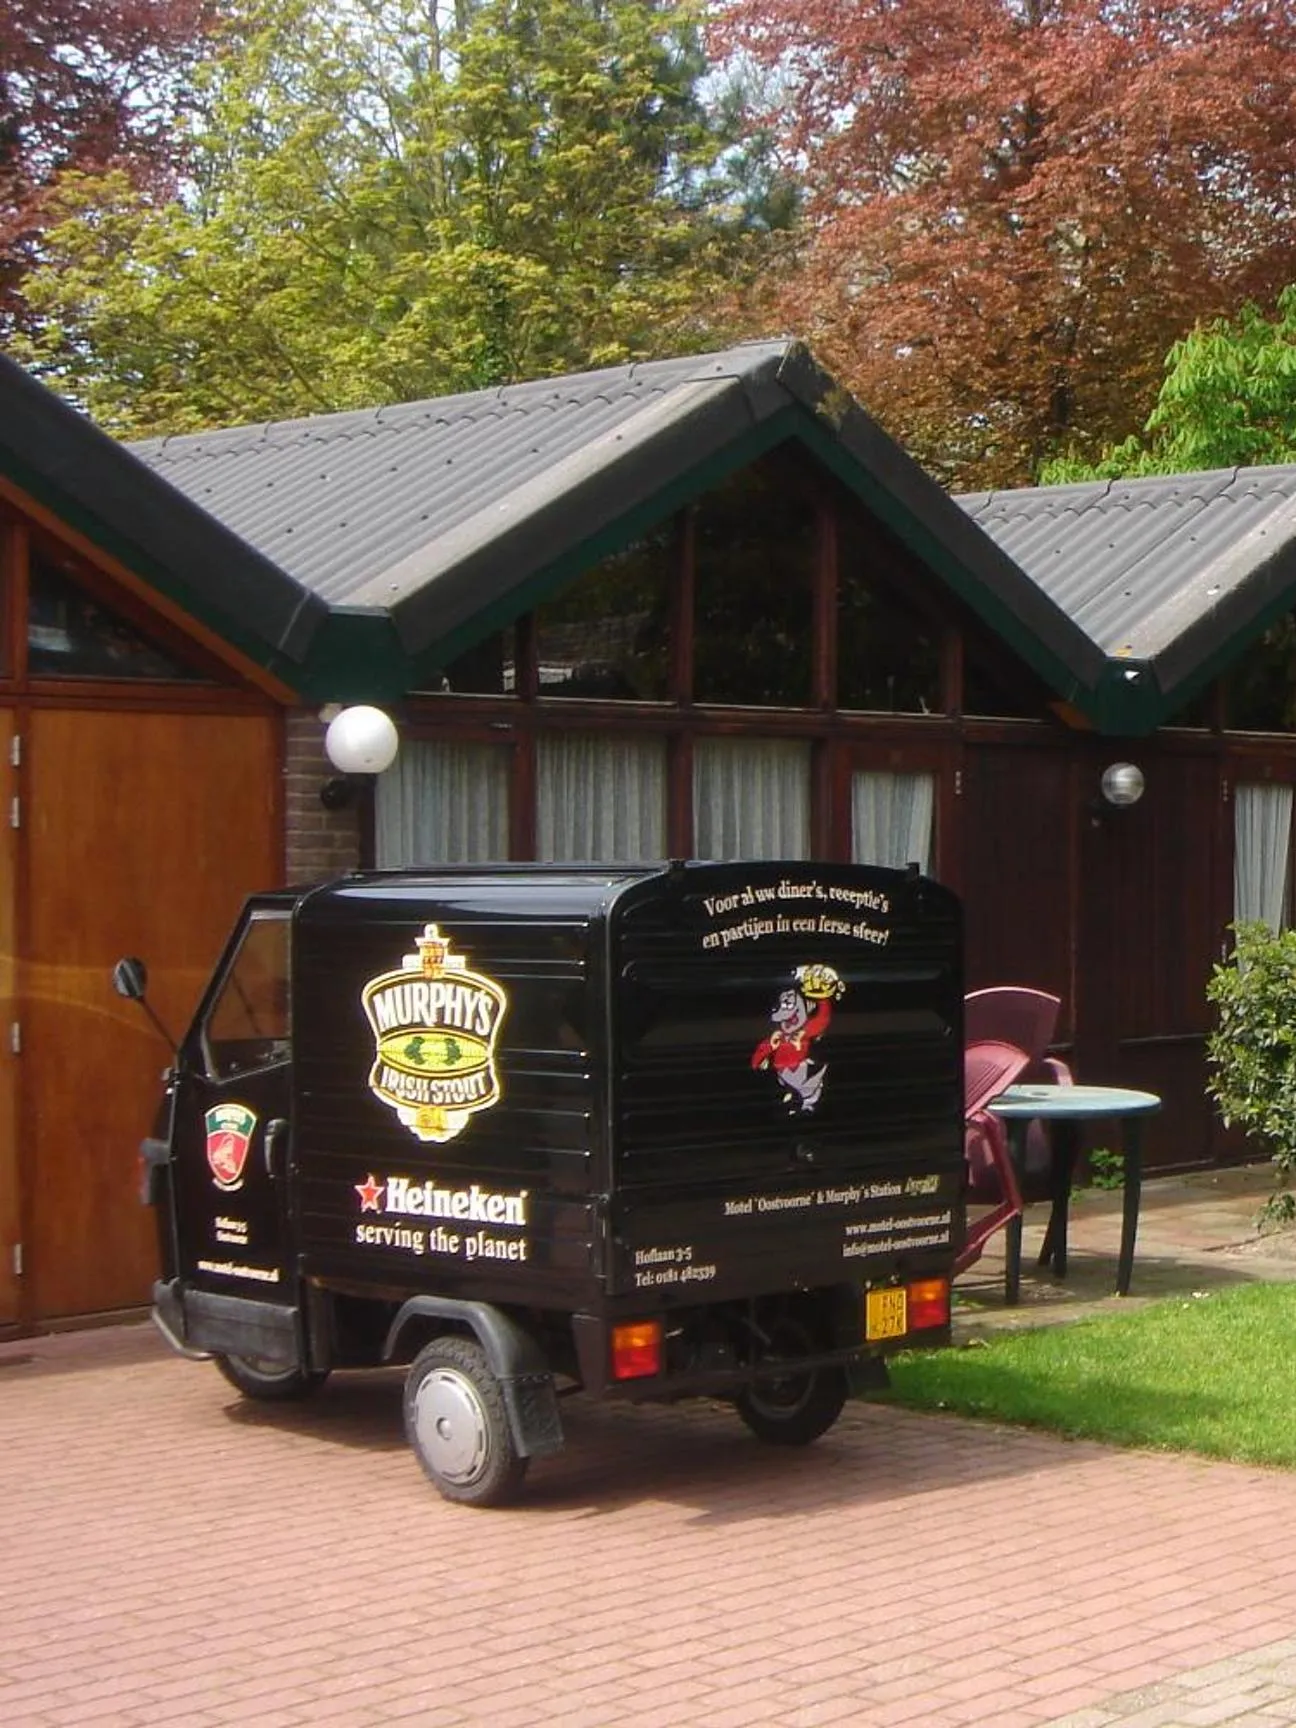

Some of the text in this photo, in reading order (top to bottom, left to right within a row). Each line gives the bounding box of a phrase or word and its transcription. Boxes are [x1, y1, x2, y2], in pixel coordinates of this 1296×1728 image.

[703, 880, 890, 917] Voor al uw diner's, receptie's
[702, 914, 889, 949] en partijen in een Ierse sfeer!
[372, 982, 494, 1036] MURPHY'S
[381, 1066, 487, 1104] IRISH STOUT
[386, 1176, 527, 1226] Heineken
[816, 1192, 825, 1205] &
[871, 1183, 901, 1198] Station
[355, 1222, 527, 1261] serving the planet
[675, 1246, 692, 1262] 3-5
[635, 1271, 654, 1287] Tel:
